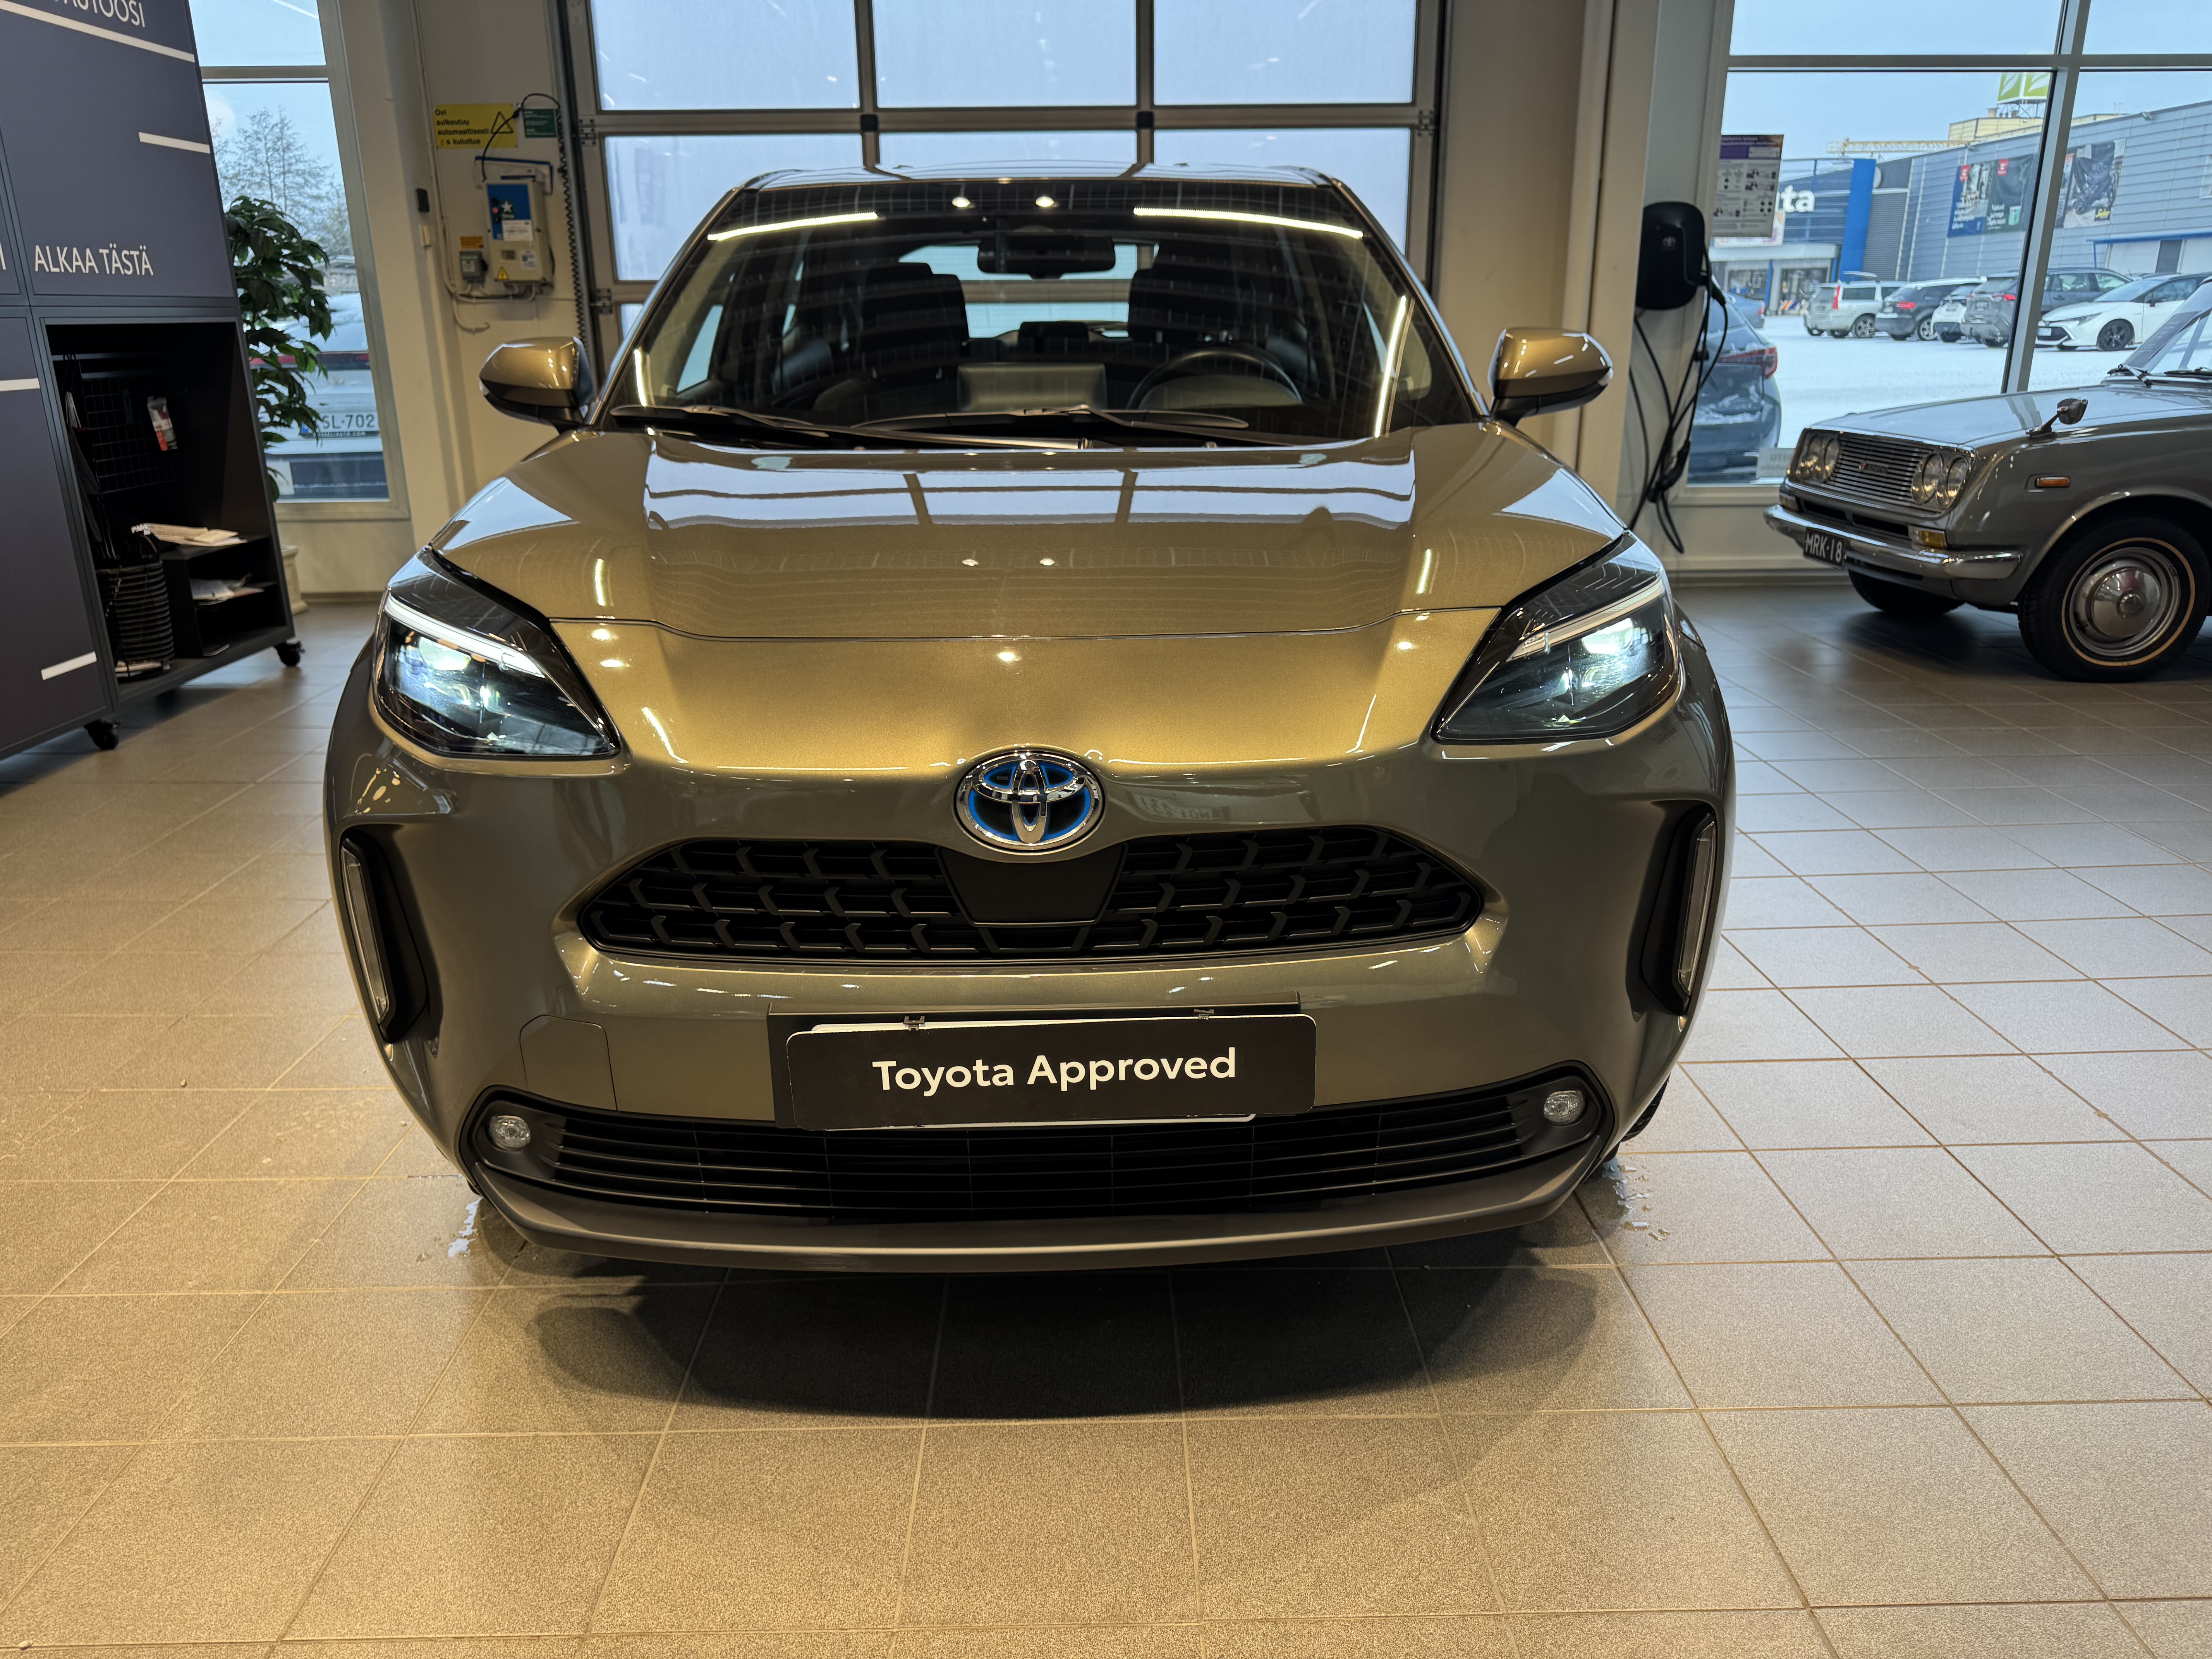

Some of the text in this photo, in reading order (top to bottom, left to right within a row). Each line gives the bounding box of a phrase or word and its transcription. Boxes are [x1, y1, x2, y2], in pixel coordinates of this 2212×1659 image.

[64, 0, 145, 27] OOSI
[1775, 185, 1815, 213] ta
[35, 245, 99, 274] ALKAA
[99, 243, 154, 275] TÄSTÄ
[322, 414, 375, 429] SL-702
[1805, 532, 1843, 563] MRK-18
[872, 1047, 1235, 1097] Toyota Approved
